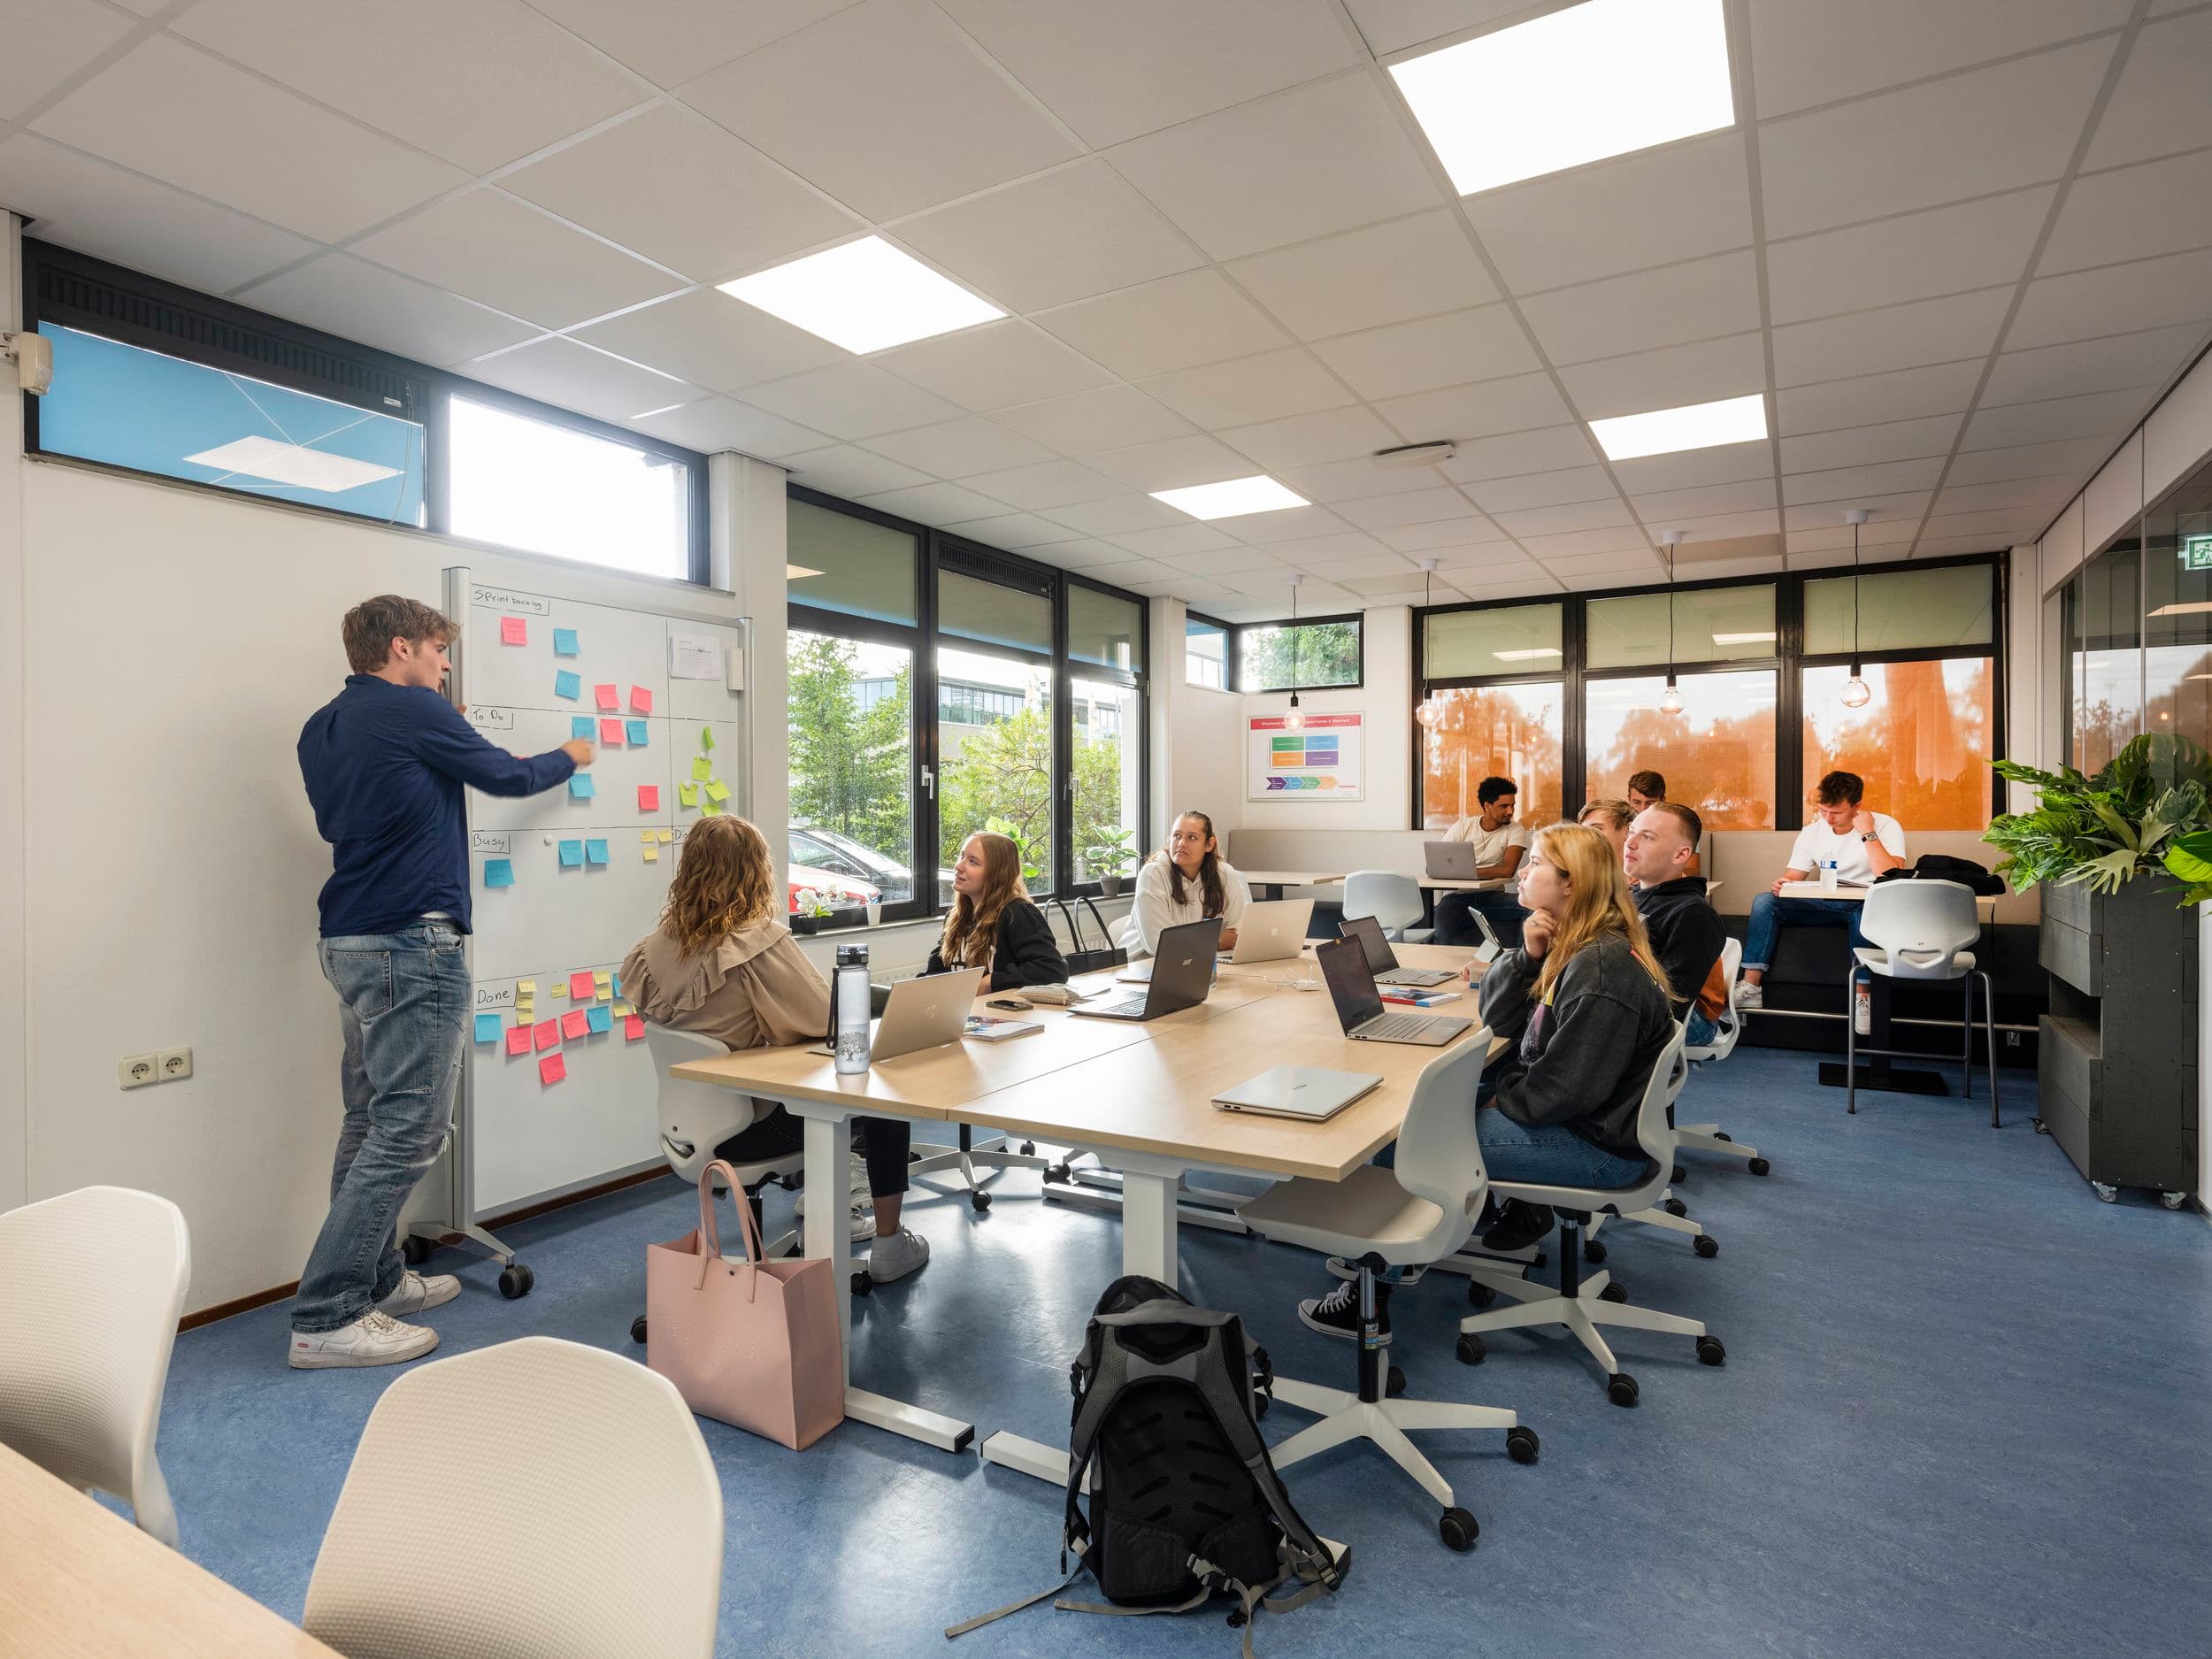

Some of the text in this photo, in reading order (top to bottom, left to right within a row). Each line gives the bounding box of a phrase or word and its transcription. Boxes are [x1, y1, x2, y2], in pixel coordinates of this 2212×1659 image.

[472, 708, 503, 720] To Do
[473, 833, 505, 851] Busy
[478, 989, 511, 1004] Done
